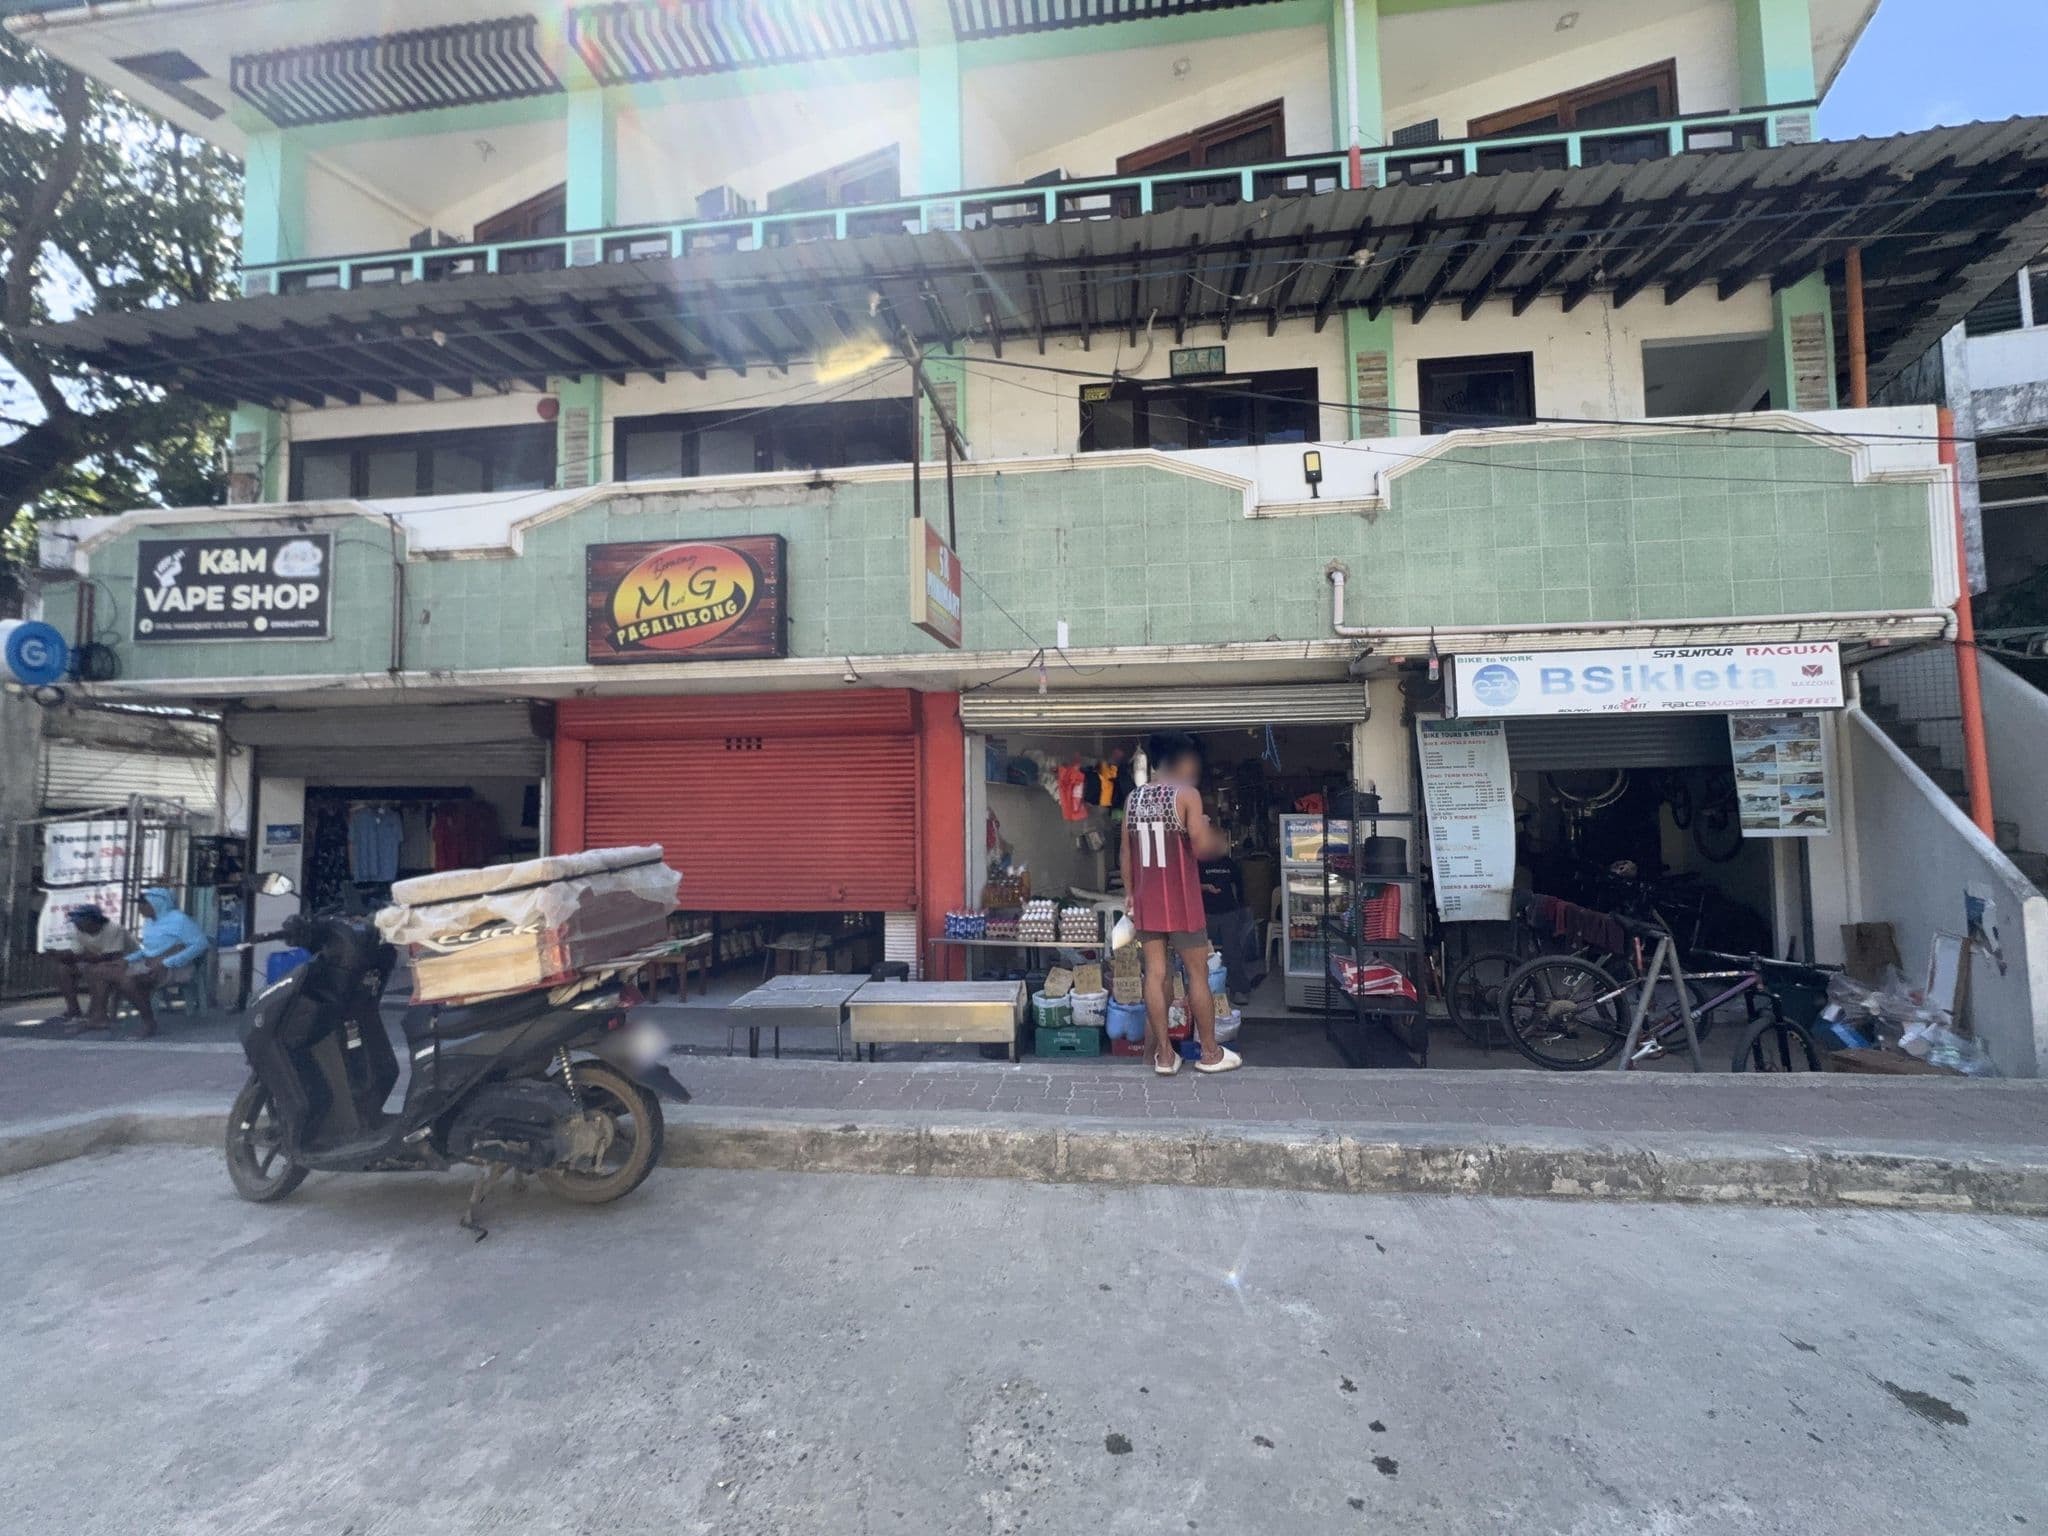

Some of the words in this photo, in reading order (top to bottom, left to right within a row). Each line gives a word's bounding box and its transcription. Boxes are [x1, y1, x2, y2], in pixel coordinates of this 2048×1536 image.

[199, 548, 267, 575] K&M
[143, 586, 226, 613] VAPE
[231, 583, 320, 610] SHOP
[688, 566, 717, 600] G
[616, 600, 738, 645] PASALUBONG
[1499, 654, 1534, 663] WORK
[1745, 644, 1833, 657] RAGUSA
[1539, 663, 1778, 695] BSikleta
[1136, 821, 1167, 868] 11
